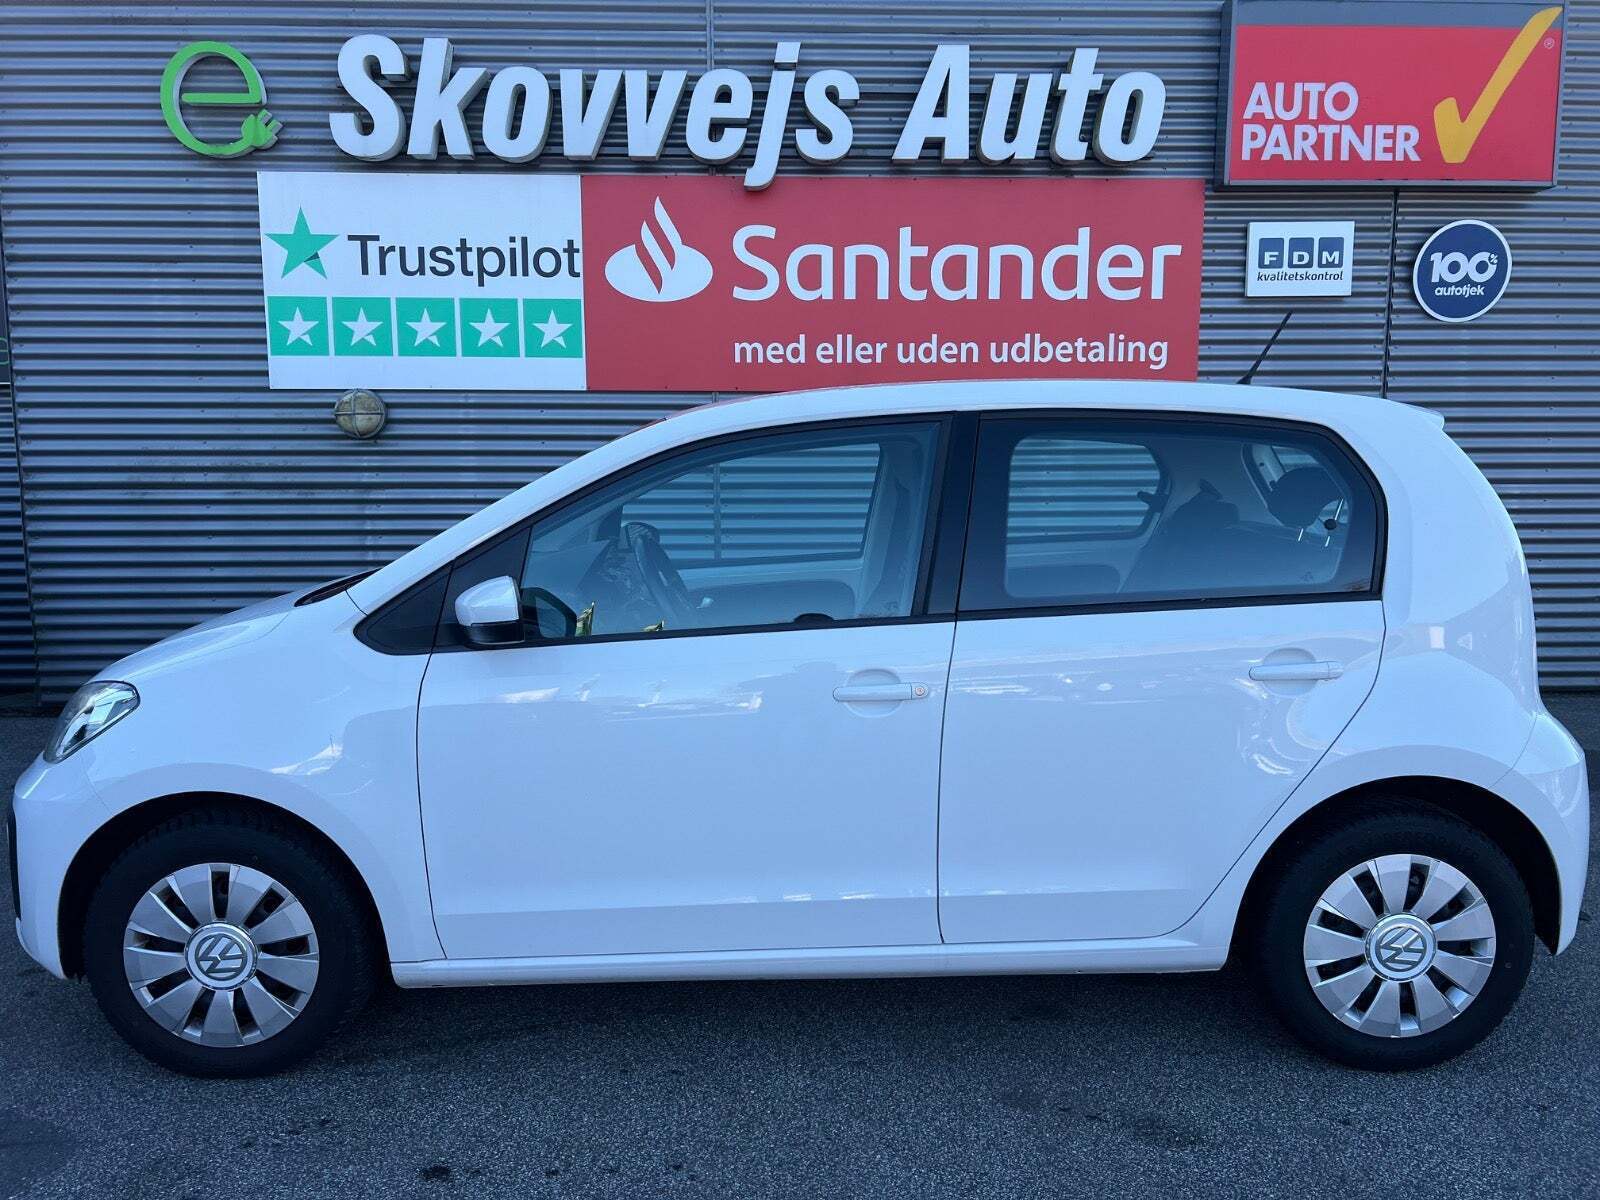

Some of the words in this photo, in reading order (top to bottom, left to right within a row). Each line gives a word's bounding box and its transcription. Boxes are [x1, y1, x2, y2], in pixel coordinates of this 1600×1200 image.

[328, 34, 860, 191] Skovvejs
[892, 44, 1166, 166] Auto
[1242, 81, 1359, 121] AUTO
[1241, 123, 1421, 162] PARTNER
[347, 234, 581, 286] Trustpilot
[731, 225, 1182, 302] Santander
[1257, 271, 1343, 282] kvalitetskontrol
[1262, 248, 1341, 266] FDM
[733, 335, 806, 364] med
[816, 335, 887, 364] eller
[896, 336, 980, 365] uden
[989, 334, 1169, 370] udbetaling
